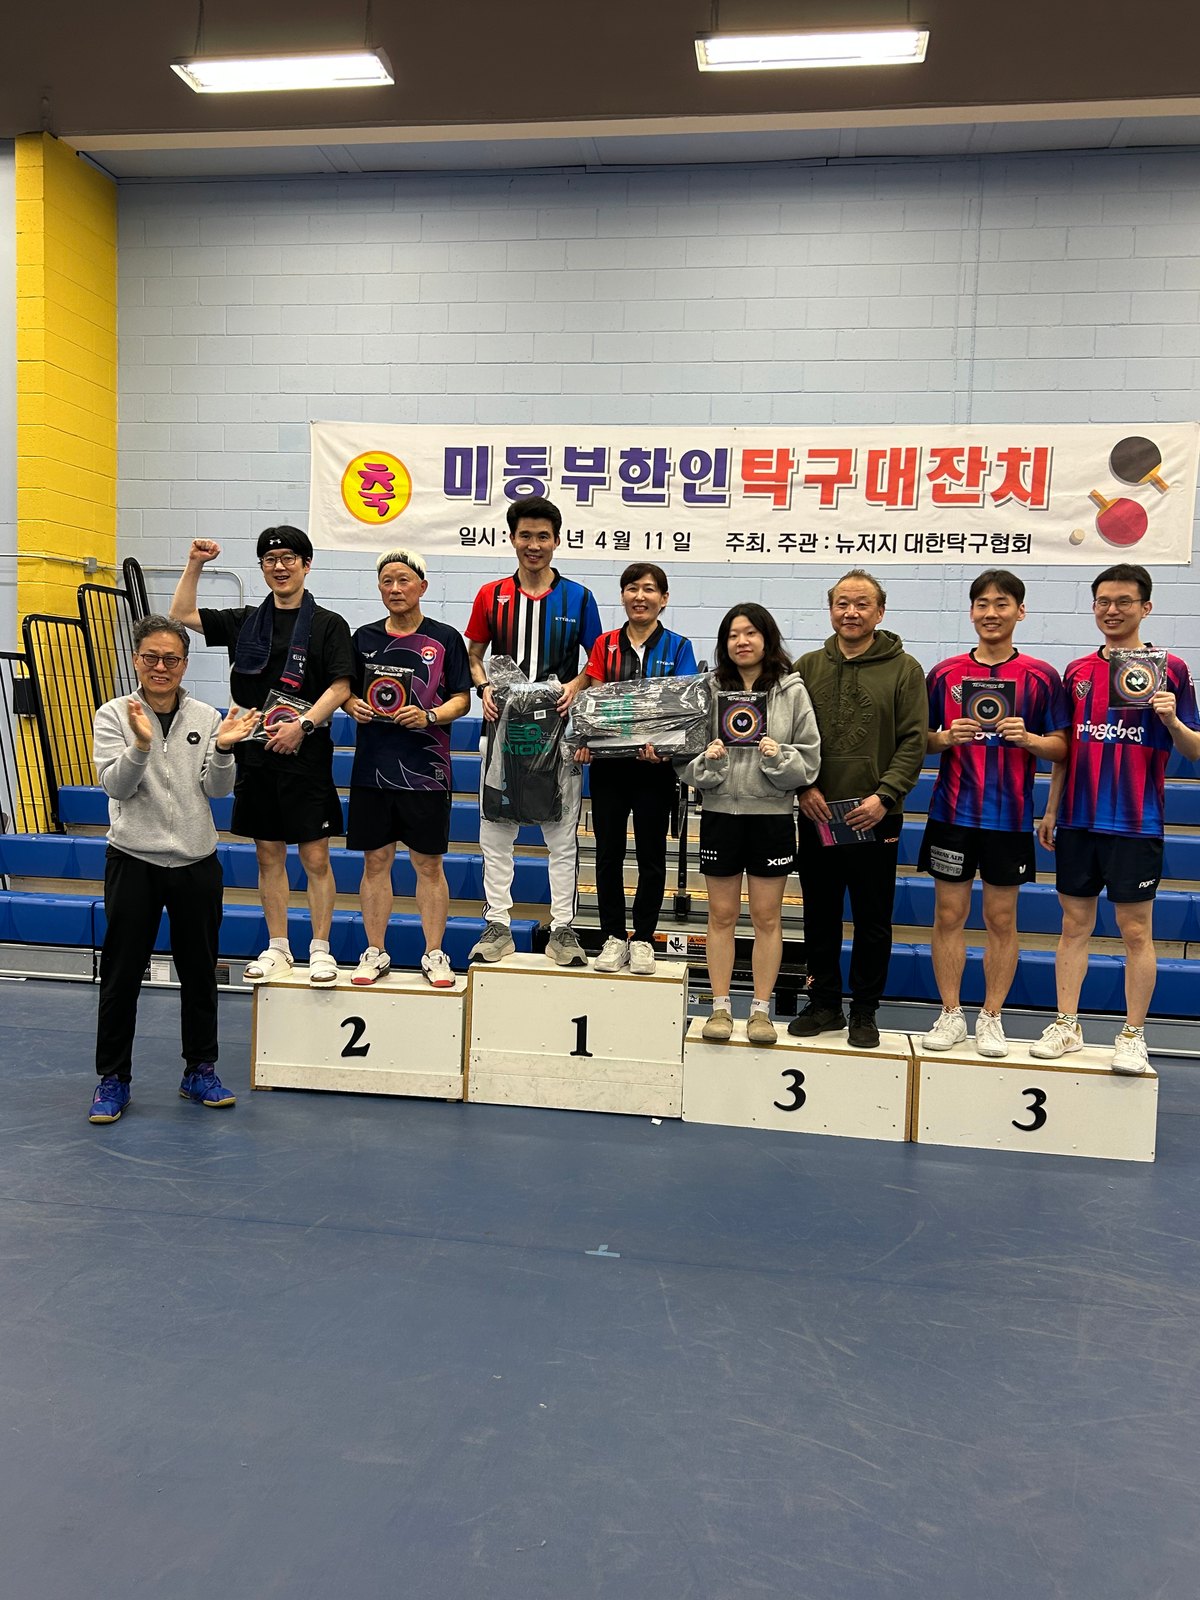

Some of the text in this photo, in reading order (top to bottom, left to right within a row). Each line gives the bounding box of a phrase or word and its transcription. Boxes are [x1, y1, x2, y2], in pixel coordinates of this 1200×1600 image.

[359, 463, 394, 516] 축
[836, 534, 897, 553] 뉴저지
[905, 533, 1031, 553] 대한탁구협회
[501, 743, 551, 756] XIOM
[767, 855, 793, 866] XIOM
[341, 1017, 370, 1057] 2
[570, 1015, 593, 1057] 1
[774, 1069, 806, 1111] 3
[1012, 1088, 1047, 1131] 3
